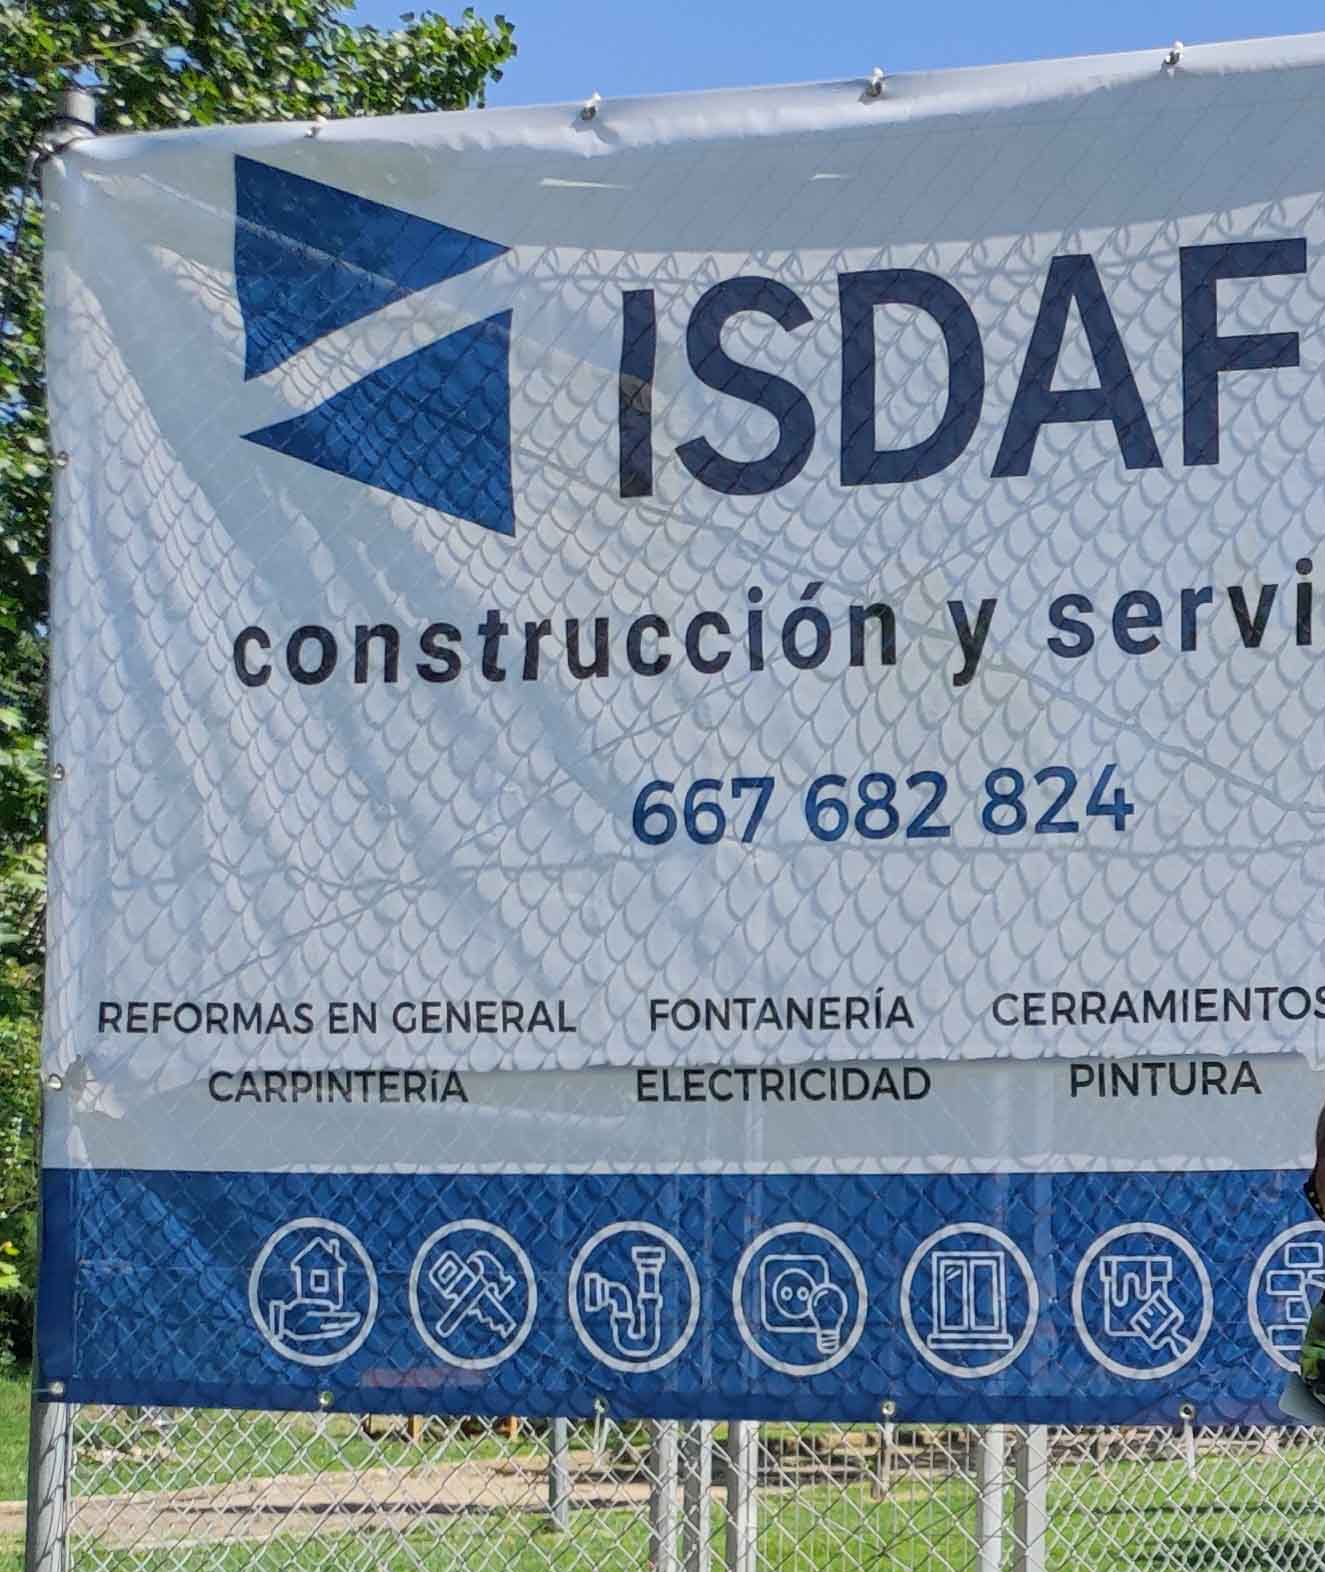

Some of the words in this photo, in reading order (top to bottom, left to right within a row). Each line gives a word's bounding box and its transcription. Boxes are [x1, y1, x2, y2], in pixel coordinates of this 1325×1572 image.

[233, 581, 898, 688] construcción
[948, 597, 998, 687] y
[632, 776, 776, 846] 667
[804, 770, 952, 841] 682
[981, 763, 1135, 837] 824
[97, 1000, 315, 1036] REFORMAS
[330, 1001, 379, 1035] EN
[391, 999, 578, 1035] GENERAL
[648, 987, 914, 1032] FONTANERÍA
[635, 1067, 932, 1103] ELECTRICIDAD
[1069, 1060, 1262, 1098] PINTURA
